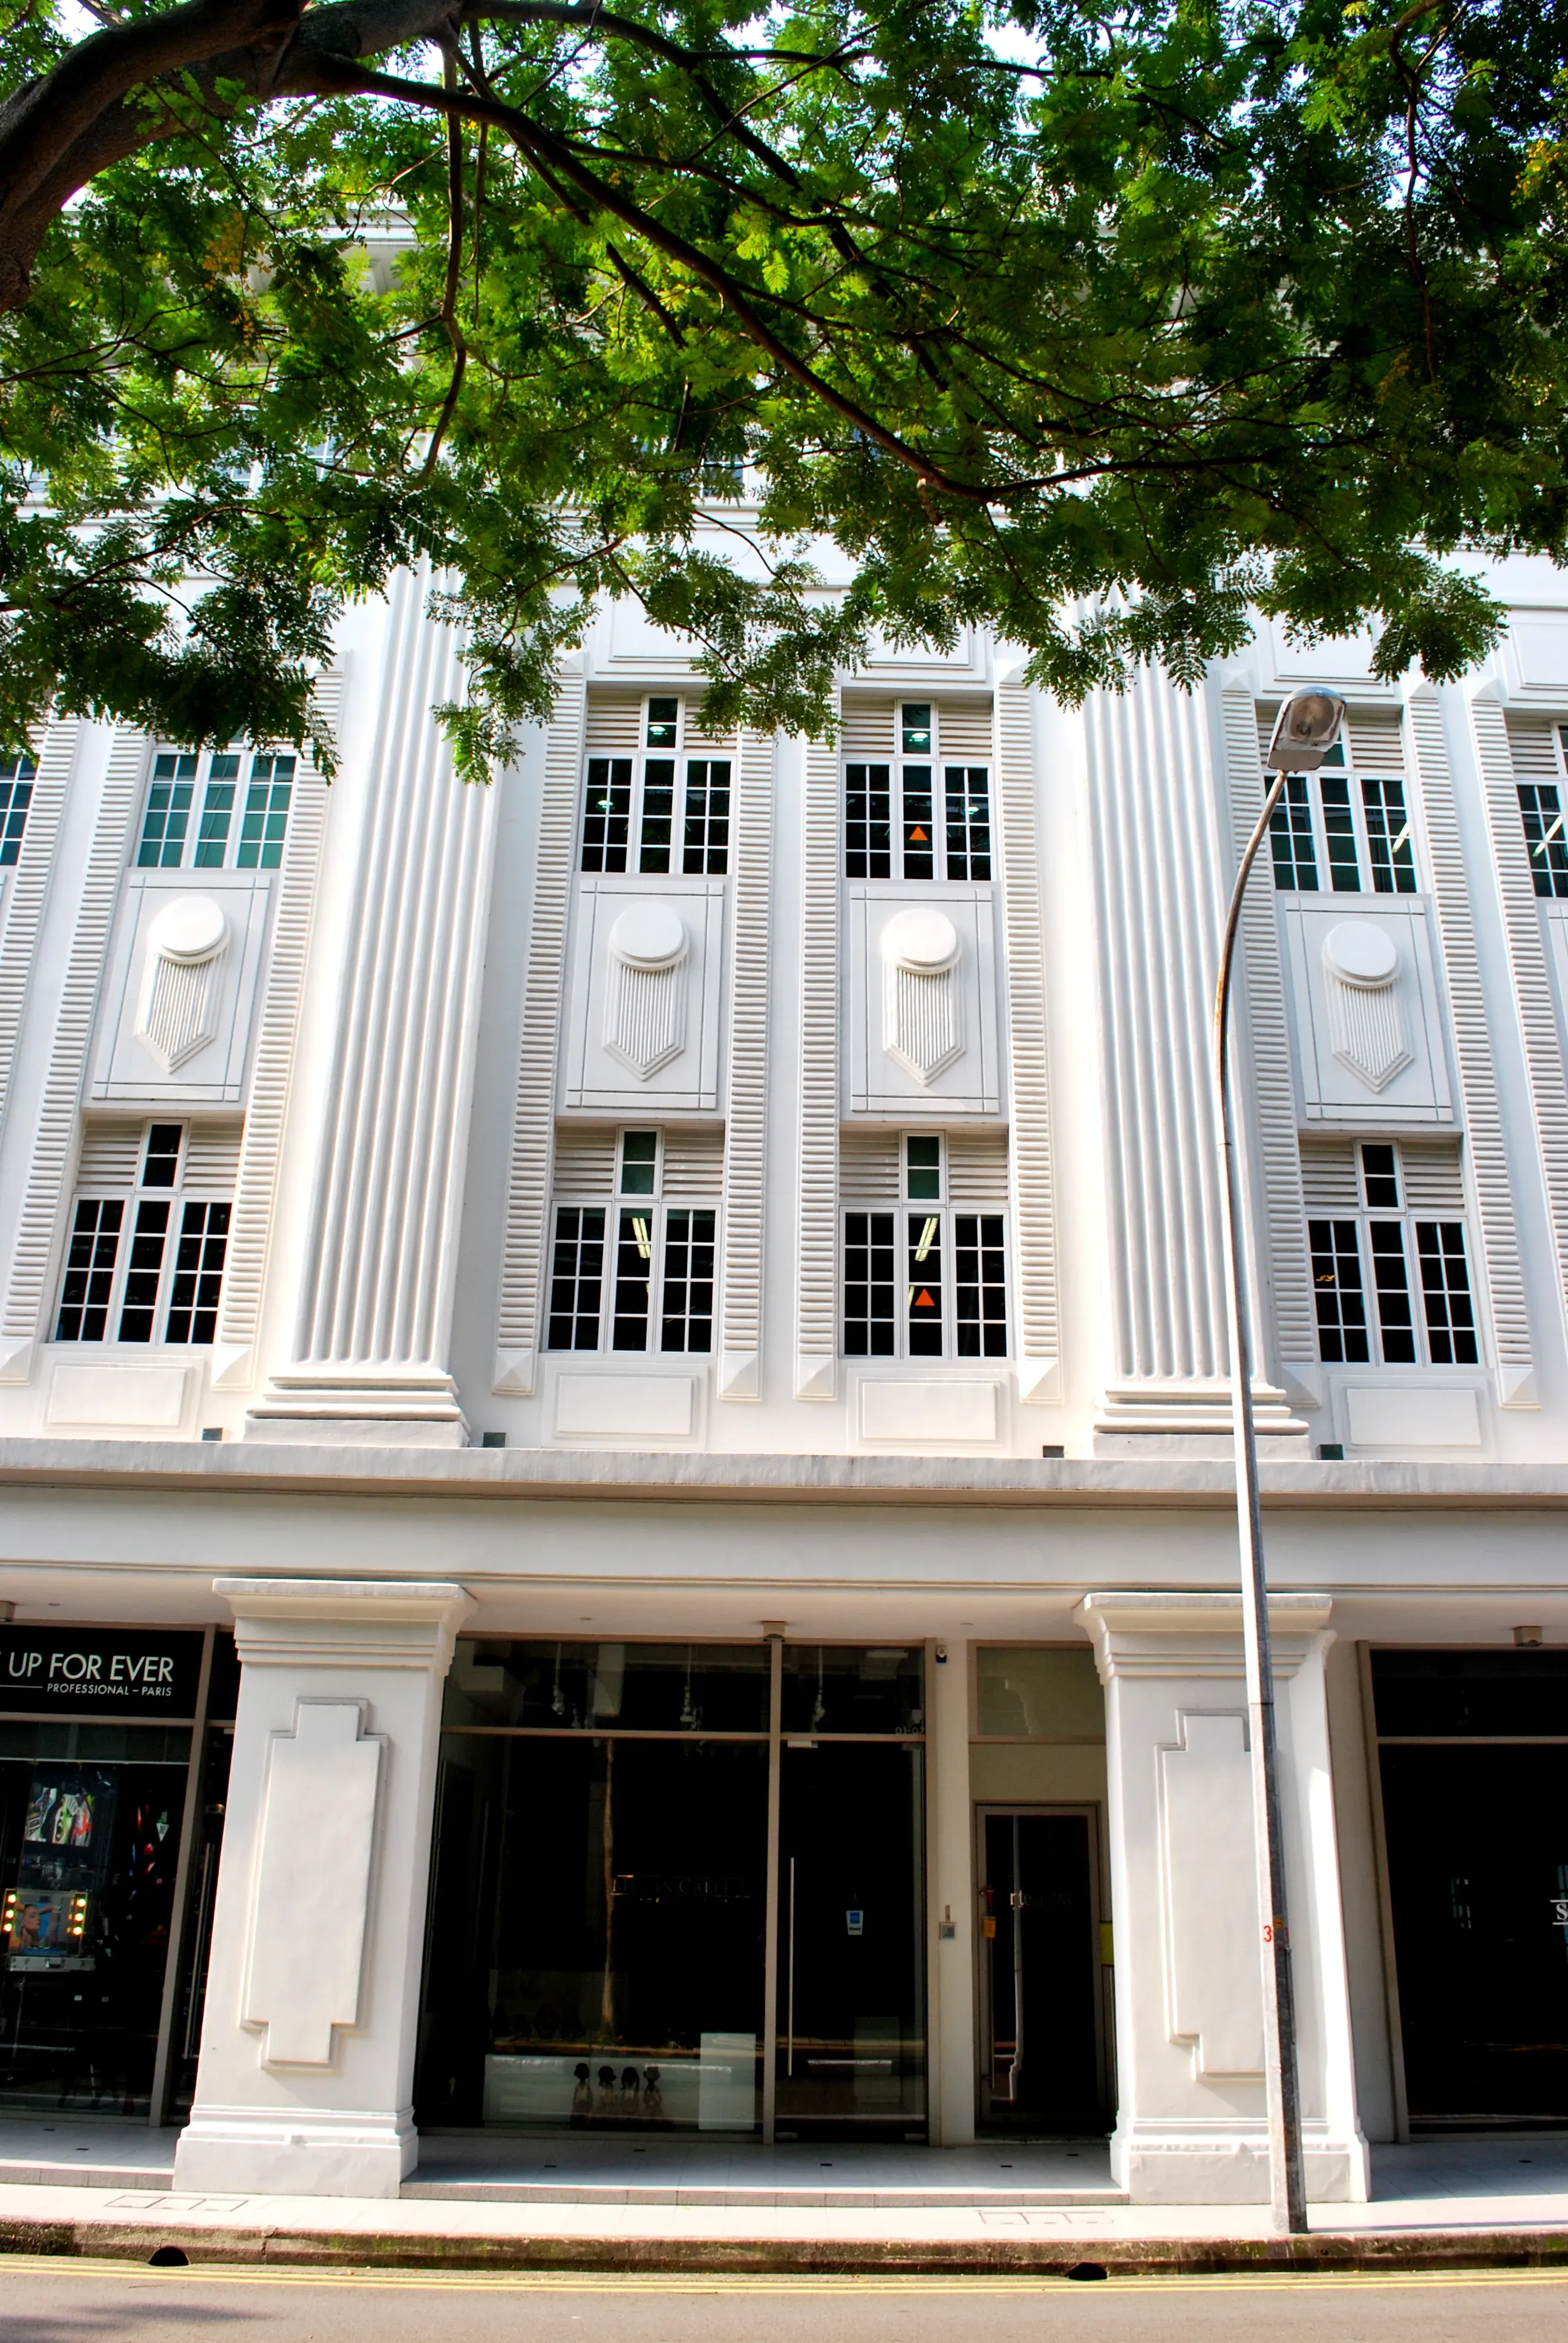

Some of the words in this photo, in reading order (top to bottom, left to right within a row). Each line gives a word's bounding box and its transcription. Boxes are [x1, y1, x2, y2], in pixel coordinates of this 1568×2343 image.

[9, 1652, 42, 1677] UP
[49, 1653, 102, 1679] FOR
[110, 1656, 174, 1682] EVER
[47, 1683, 129, 1695] PROFESSIONAL
[142, 1686, 172, 1697] PARIS
[1264, 1925, 1272, 1942] 3
